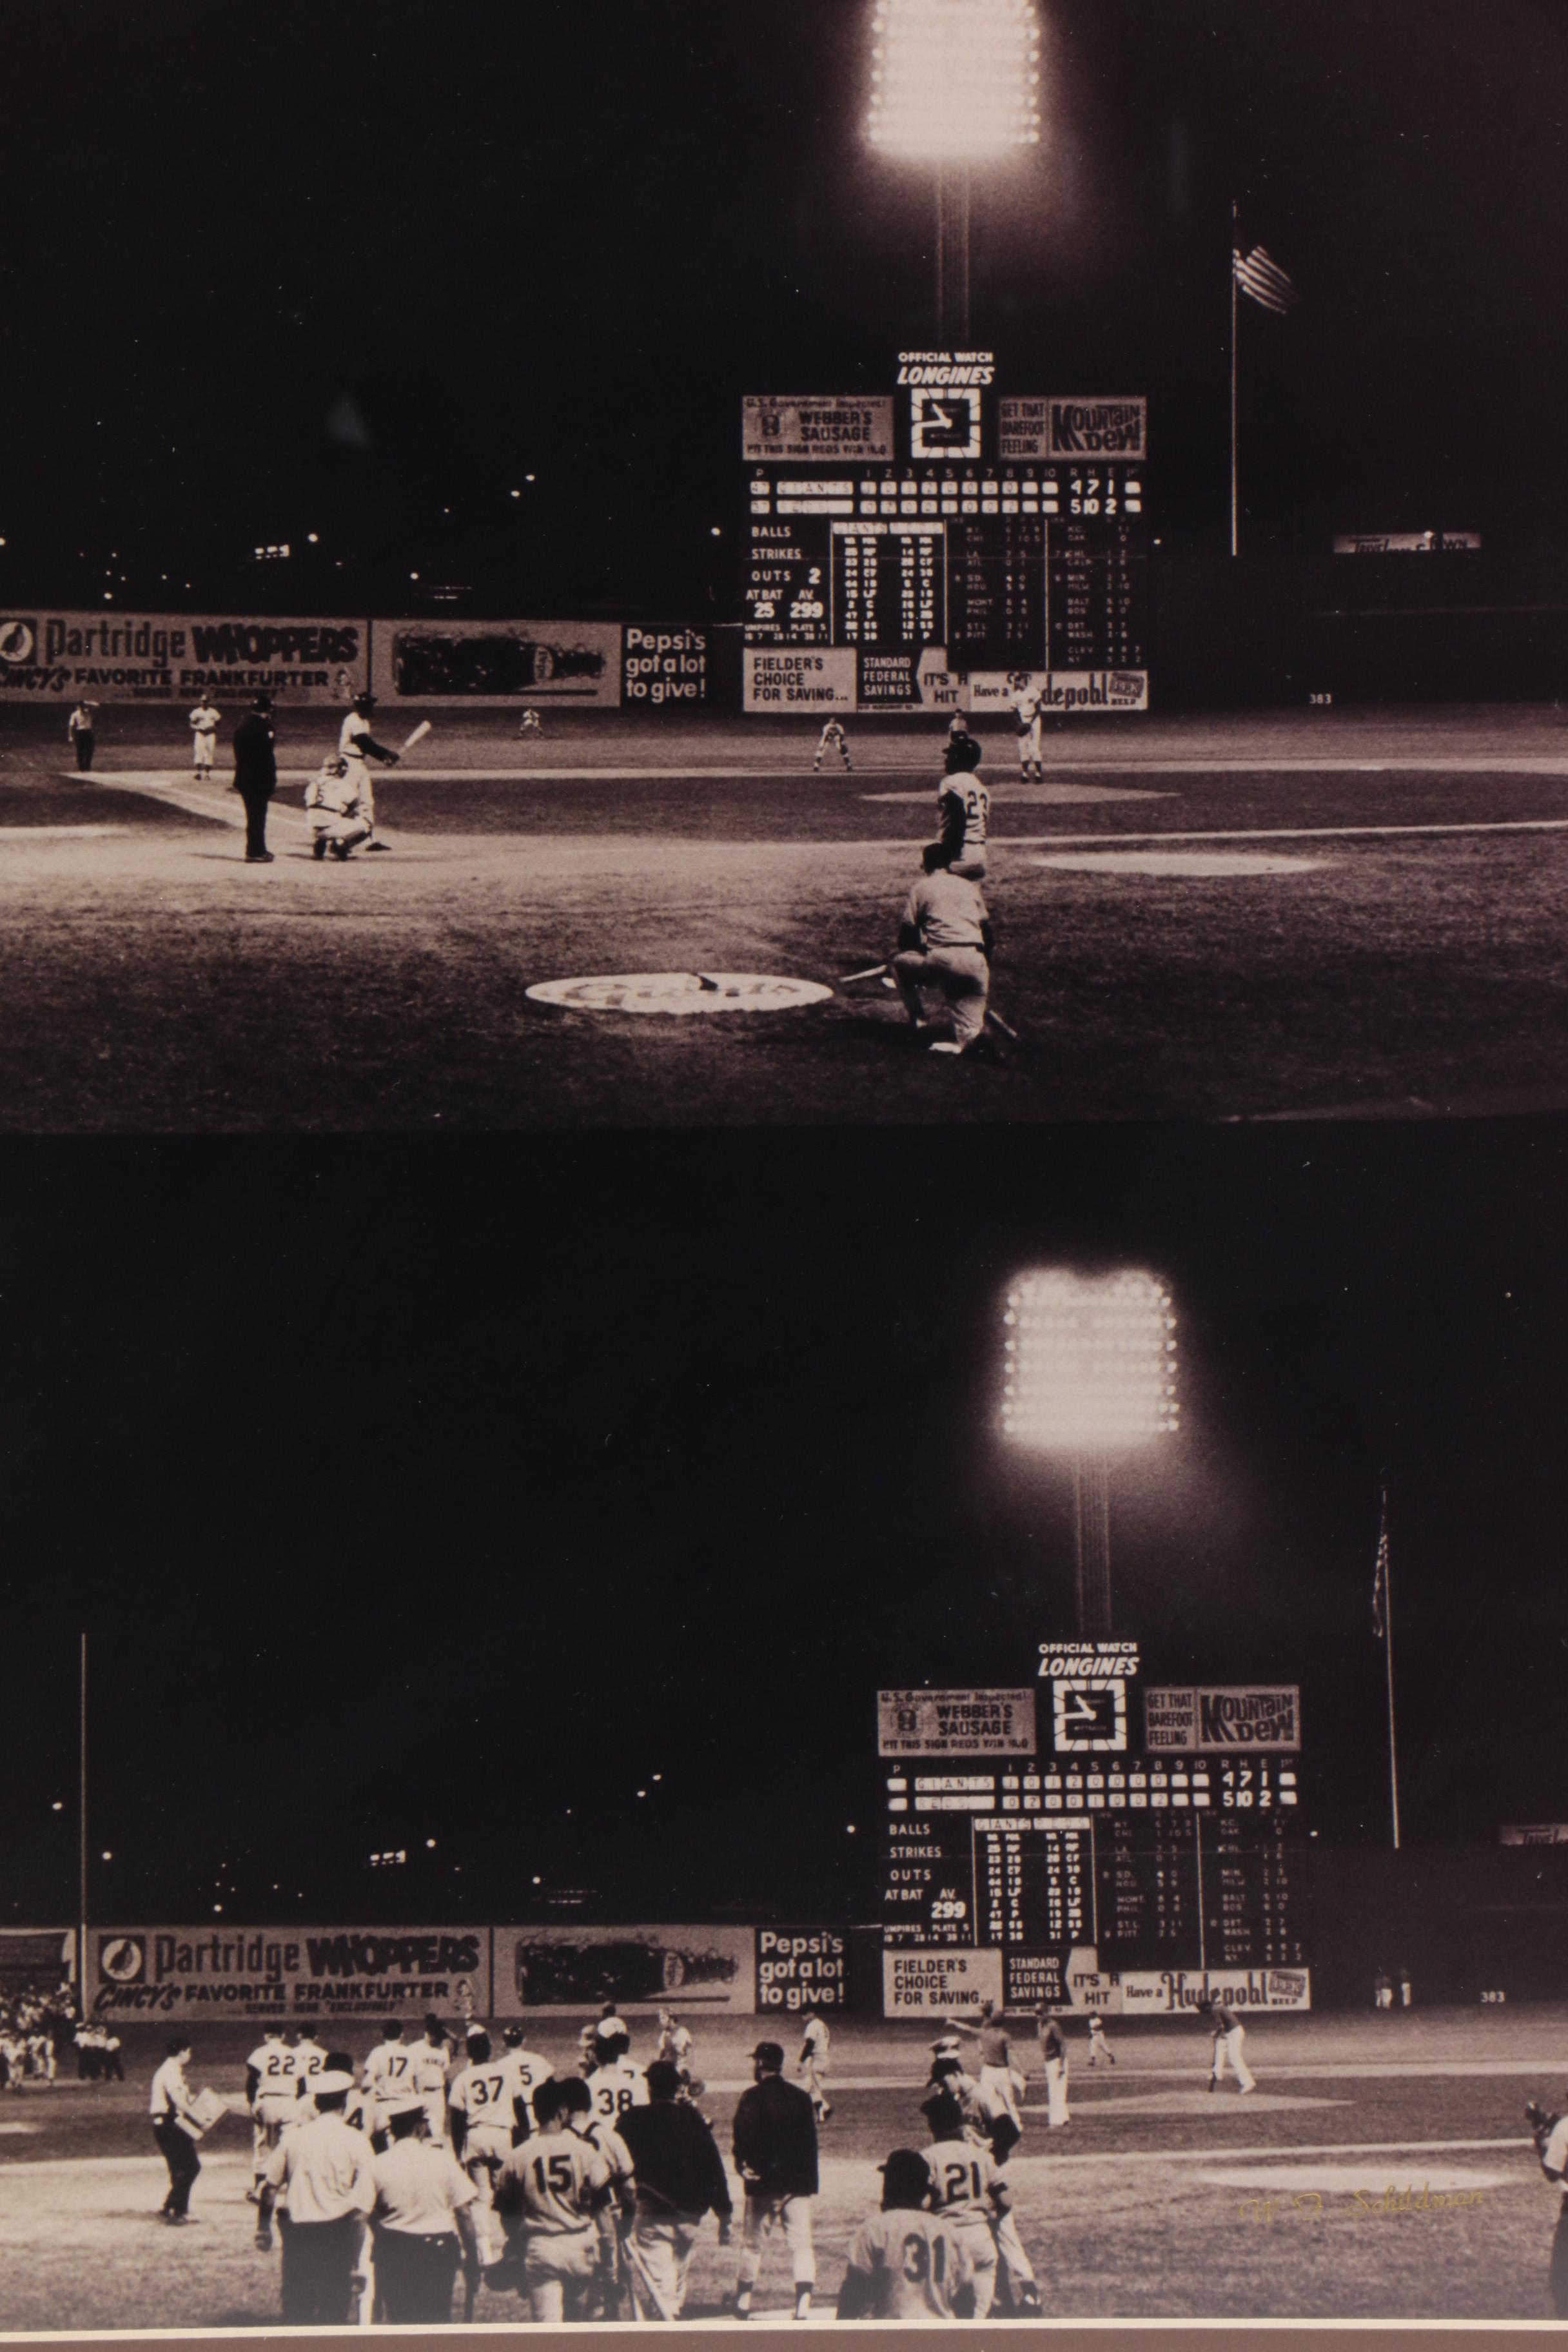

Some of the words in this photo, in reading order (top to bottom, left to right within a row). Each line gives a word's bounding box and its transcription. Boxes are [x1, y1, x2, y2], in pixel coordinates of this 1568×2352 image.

[898, 353, 952, 363] OFFICIAL
[954, 353, 993, 363] WATCH
[897, 366, 995, 385] LONGINES
[1001, 403, 1019, 417] GET
[1021, 402, 1044, 417] THAT
[801, 427, 870, 442] SAUSAGE
[1001, 420, 1044, 436] BAREFOOT
[1002, 438, 1039, 454] FEELING
[1071, 479, 1082, 495] 4
[1087, 479, 1099, 495] 7
[1108, 479, 1114, 495] 1
[1071, 498, 1081, 514] 5
[1083, 498, 1099, 514] 10
[1105, 498, 1117, 514] 2
[751, 526, 791, 537] BALLS
[751, 548, 801, 560] STRIKES
[751, 570, 791, 581] OUTS
[808, 567, 821, 584] 2
[746, 589, 760, 600] AT
[761, 589, 783, 600] BAT
[790, 602, 824, 618] 299
[46, 618, 185, 668] Partridge
[191, 622, 359, 664] WHOPPERS
[627, 628, 706, 654] Pepsi's
[627, 654, 660, 677] got
[664, 658, 677, 673] a
[681, 656, 706, 673] lot
[754, 657, 823, 671] FIELDER'S
[863, 657, 911, 668] STANDARD
[74, 668, 173, 685] FAVORITE
[181, 669, 329, 687] FRANKFURTER
[754, 672, 804, 686] CHOICE
[863, 671, 910, 681] FEDERAL
[925, 673, 949, 686] IT'S
[627, 678, 647, 697] to
[754, 687, 781, 701] FOR
[863, 684, 911, 696] SAVINGS
[974, 685, 999, 697] Have
[1001, 688, 1008, 697] a
[935, 691, 959, 703] HIT
[1309, 693, 1332, 704] 383
[1039, 1643, 1094, 1654] OFFICIAL
[1096, 1642, 1137, 1653] WATCH
[1038, 1657, 1139, 1676] LONGINES
[1148, 1694, 1166, 1709] GET
[1169, 1692, 1191, 1708] THAT
[937, 1703, 1013, 1720] WEBBER'S
[1148, 1711, 1193, 1727] BAREFOOT
[939, 1720, 1011, 1736] SAUSAGE
[1149, 1730, 1188, 1746] FEELING
[893, 1765, 901, 1774] P
[1008, 1763, 1012, 1772] 1
[1028, 1763, 1035, 1772] 2
[1050, 1762, 1057, 1772] 3
[1070, 1762, 1079, 1772] 4
[1091, 1761, 1099, 1772] 5
[1112, 1761, 1120, 1771] 6
[1133, 1761, 1141, 1771] 7
[1154, 1760, 1162, 1770] 8
[1175, 1760, 1183, 1770] 9
[1195, 1760, 1207, 1770] 10
[1221, 1759, 1230, 1769] R
[1240, 1759, 1248, 1769] H
[917, 1778, 990, 1790] GIANTS
[1222, 1770, 1234, 1787] 4
[1240, 1770, 1253, 1787] 7
[1261, 1770, 1268, 1787] 1
[1223, 1791, 1234, 1807] 5
[1236, 1790, 1253, 1807] 10
[1259, 1790, 1271, 1807] 2
[889, 1823, 930, 1835] BALLS
[890, 1847, 942, 1858] STRIKES
[890, 1869, 932, 1881] OUTS
[885, 1889, 899, 1900] AT
[901, 1889, 923, 1900] BAT
[931, 1901, 966, 1919] 299
[884, 1924, 921, 1933] UMPIRES
[932, 1924, 957, 1932] PLATE
[761, 1932, 844, 1958] Pepsi's
[156, 1934, 300, 1982] Partridge
[307, 1936, 480, 1978] WHOPPERS
[894, 1959, 967, 1973] FIELDER'S
[1010, 1957, 1059, 1970] STANDARD
[760, 1957, 796, 1983] got
[799, 1961, 812, 1977] a
[816, 1958, 844, 1977] lot
[1010, 1972, 1060, 1984] FEDERAL
[894, 1975, 948, 1989] CHOICE
[1073, 1974, 1099, 1987] IT'S
[93, 1983, 182, 2012] CINCY'S
[184, 1983, 286, 2001] FAVORITE
[294, 1981, 449, 2000] FRANKFURTER
[760, 1984, 783, 2003] to
[894, 1991, 923, 2004] FOR
[1010, 1986, 1061, 1999] SAVINGS
[1084, 1991, 1110, 2005] HIT
[1126, 1985, 1153, 1998] Have
[1156, 1988, 1163, 1998] a
[268, 2055, 295, 2075] 22
[388, 2057, 408, 2077] 17
[471, 2075, 504, 2105] 37
[597, 2088, 633, 2115] 38
[533, 2154, 572, 2193] 15
[945, 2161, 982, 2202] 21
[903, 2233, 946, 2284] 31
